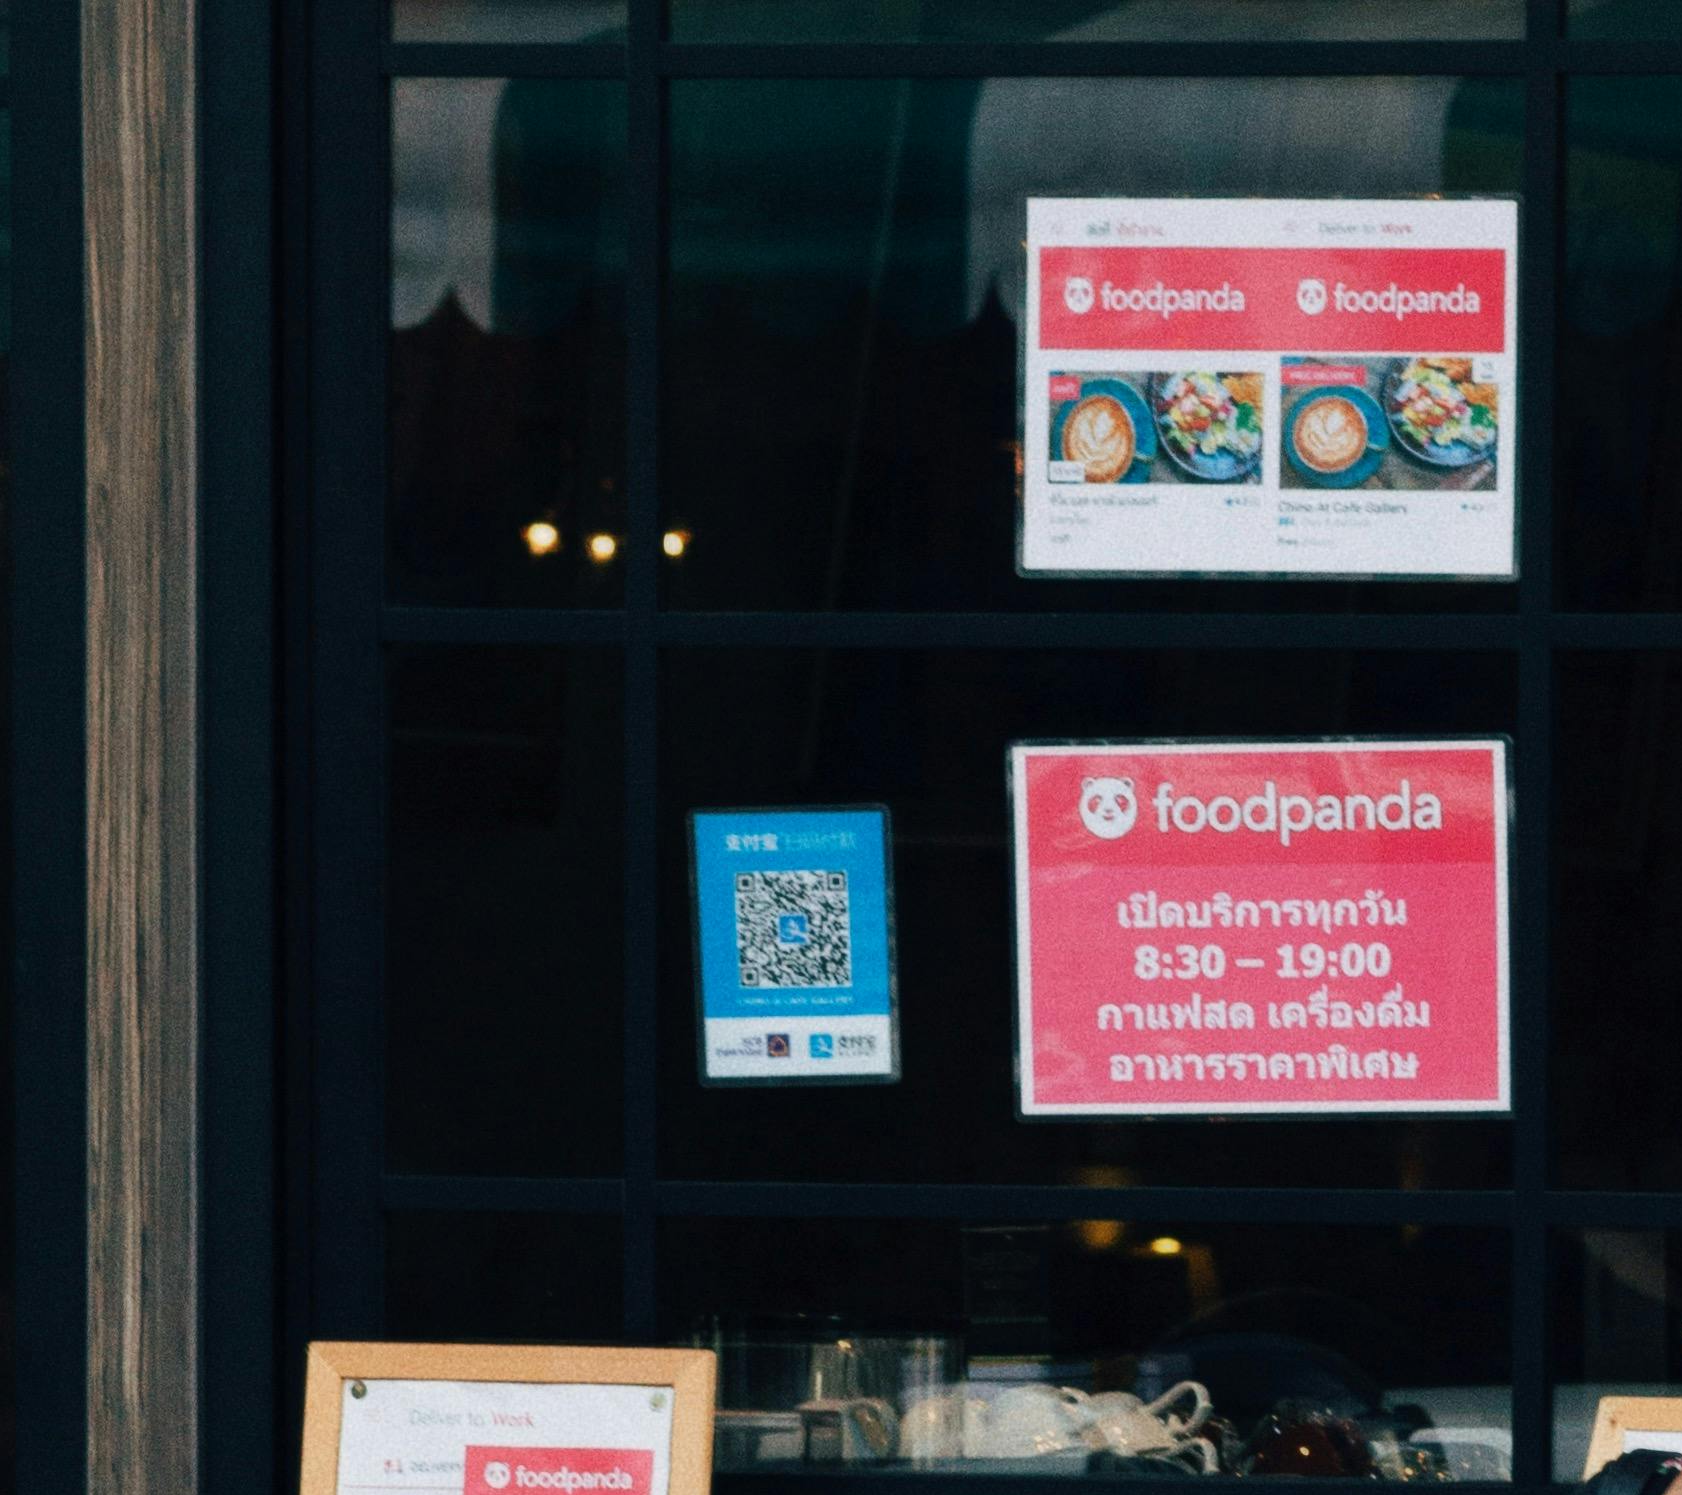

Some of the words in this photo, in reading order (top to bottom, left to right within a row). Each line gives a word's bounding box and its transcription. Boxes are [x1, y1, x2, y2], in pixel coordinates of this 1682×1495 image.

[1101, 280, 1246, 320] foodpanda
[1333, 281, 1481, 321] foodpanda
[1153, 780, 1443, 847] foodpanda
[1117, 889, 1408, 933] เปิดบริการทุกวัน
[1133, 944, 1227, 981] 8:30
[1276, 942, 1392, 980] 19:00
[1097, 994, 1255, 1031] กาแฟสด
[1268, 983, 1431, 1030] เครื่องดื่ม
[1109, 1044, 1420, 1083] อาหารราคาพิเศษ
[408, 1409, 463, 1427] Deliver
[467, 1411, 487, 1427] to
[491, 1410, 535, 1428] Work
[515, 1464, 634, 1495] foodpanda
